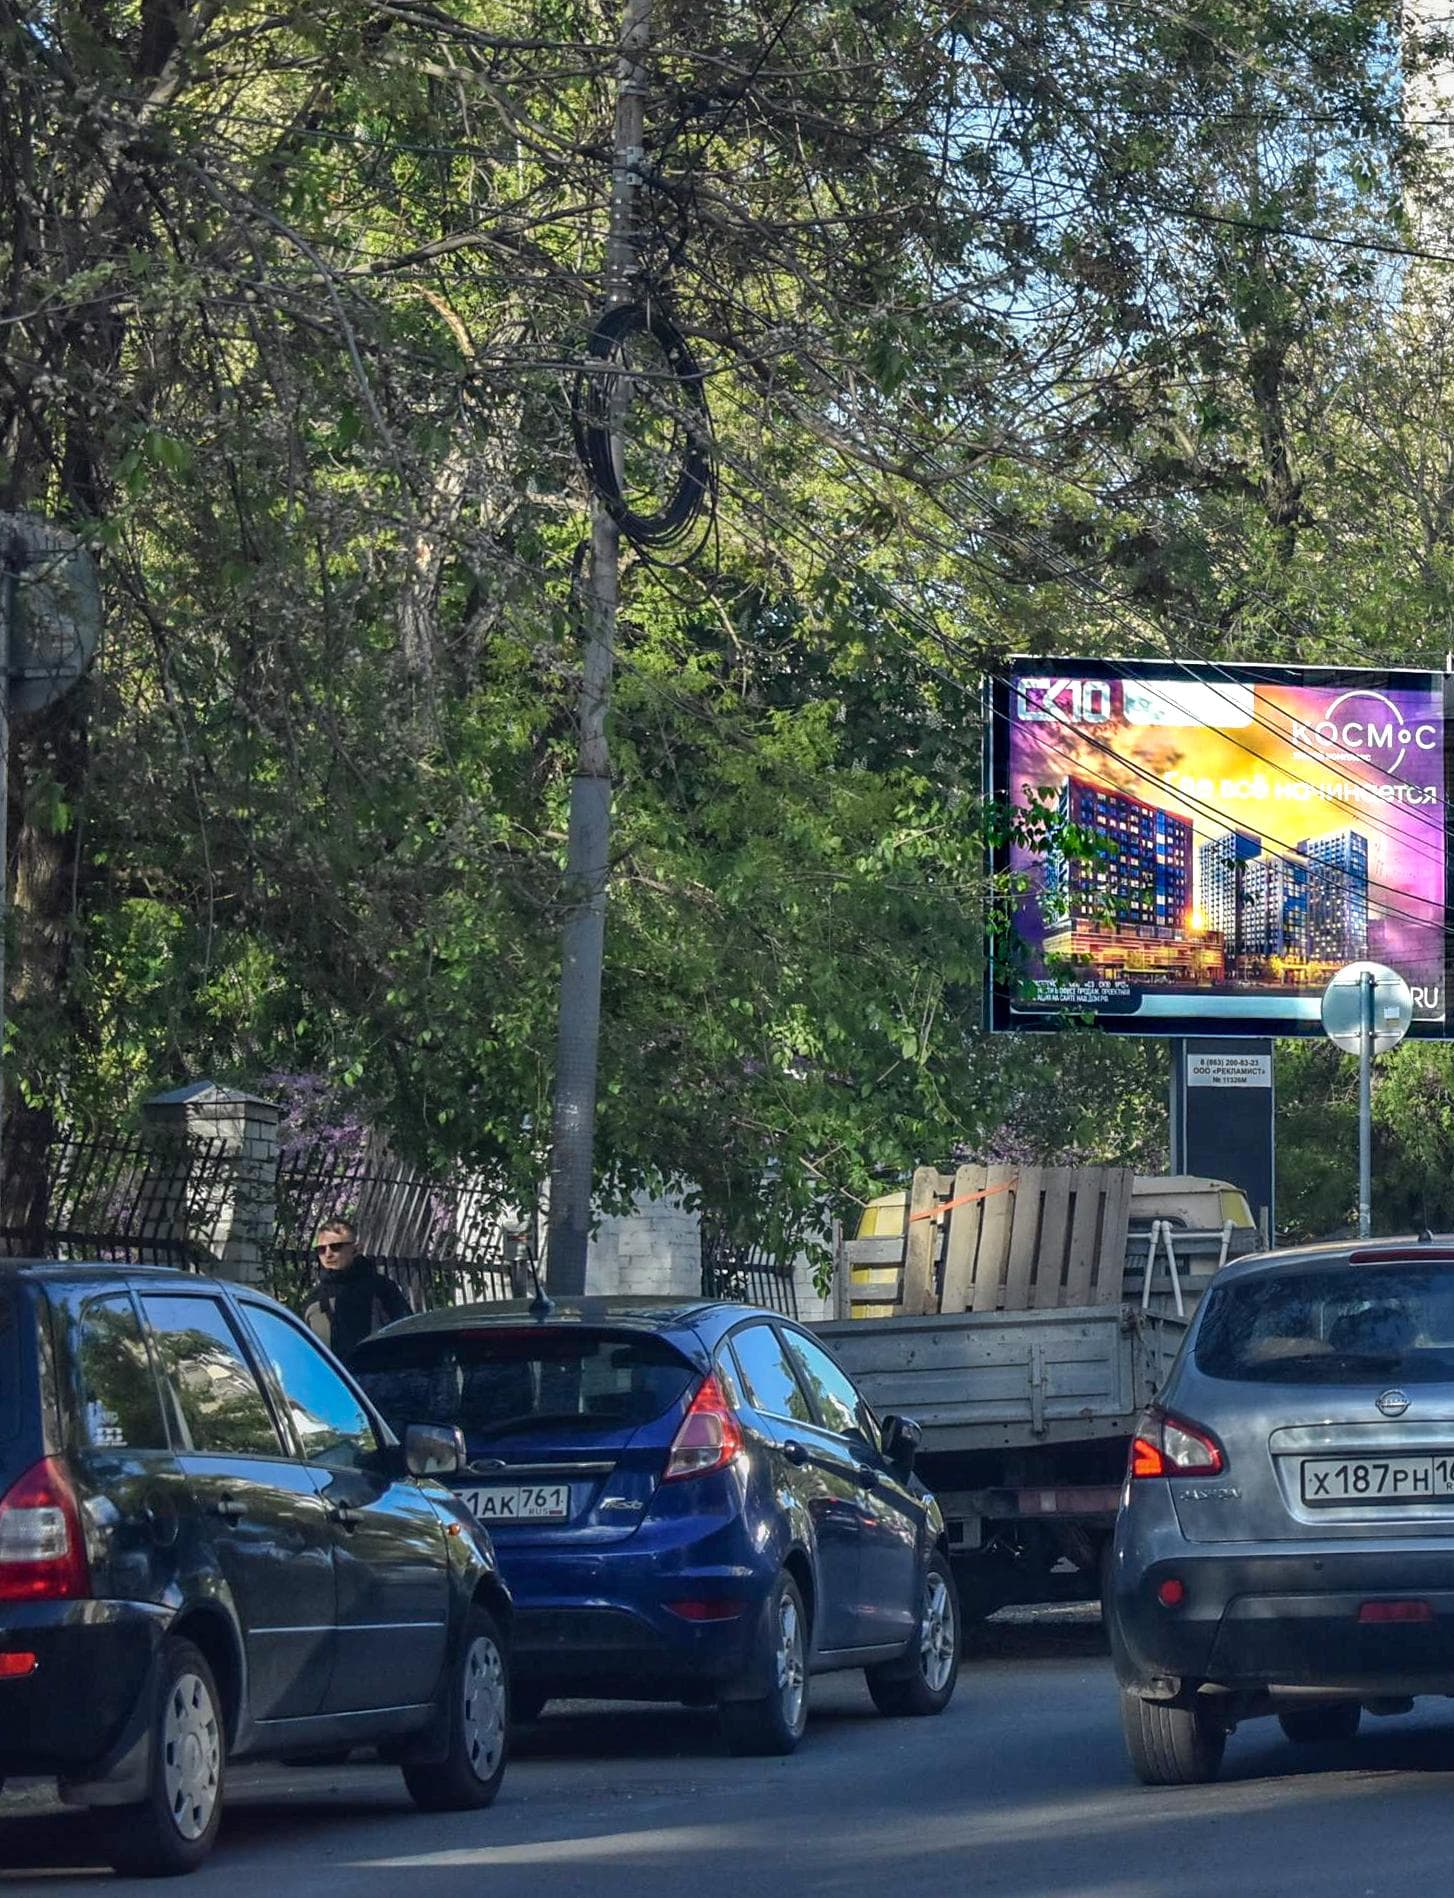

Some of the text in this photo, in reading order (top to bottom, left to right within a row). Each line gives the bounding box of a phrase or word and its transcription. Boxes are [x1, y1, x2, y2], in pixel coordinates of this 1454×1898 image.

[1292, 719, 1437, 750] КОСМОС
[1193, 1067, 1211, 1075] ООО
[1313, 1463, 1430, 1496] Х187РН
[455, 1488, 561, 1516] 1АК 761
[528, 1507, 550, 1515] RUS
